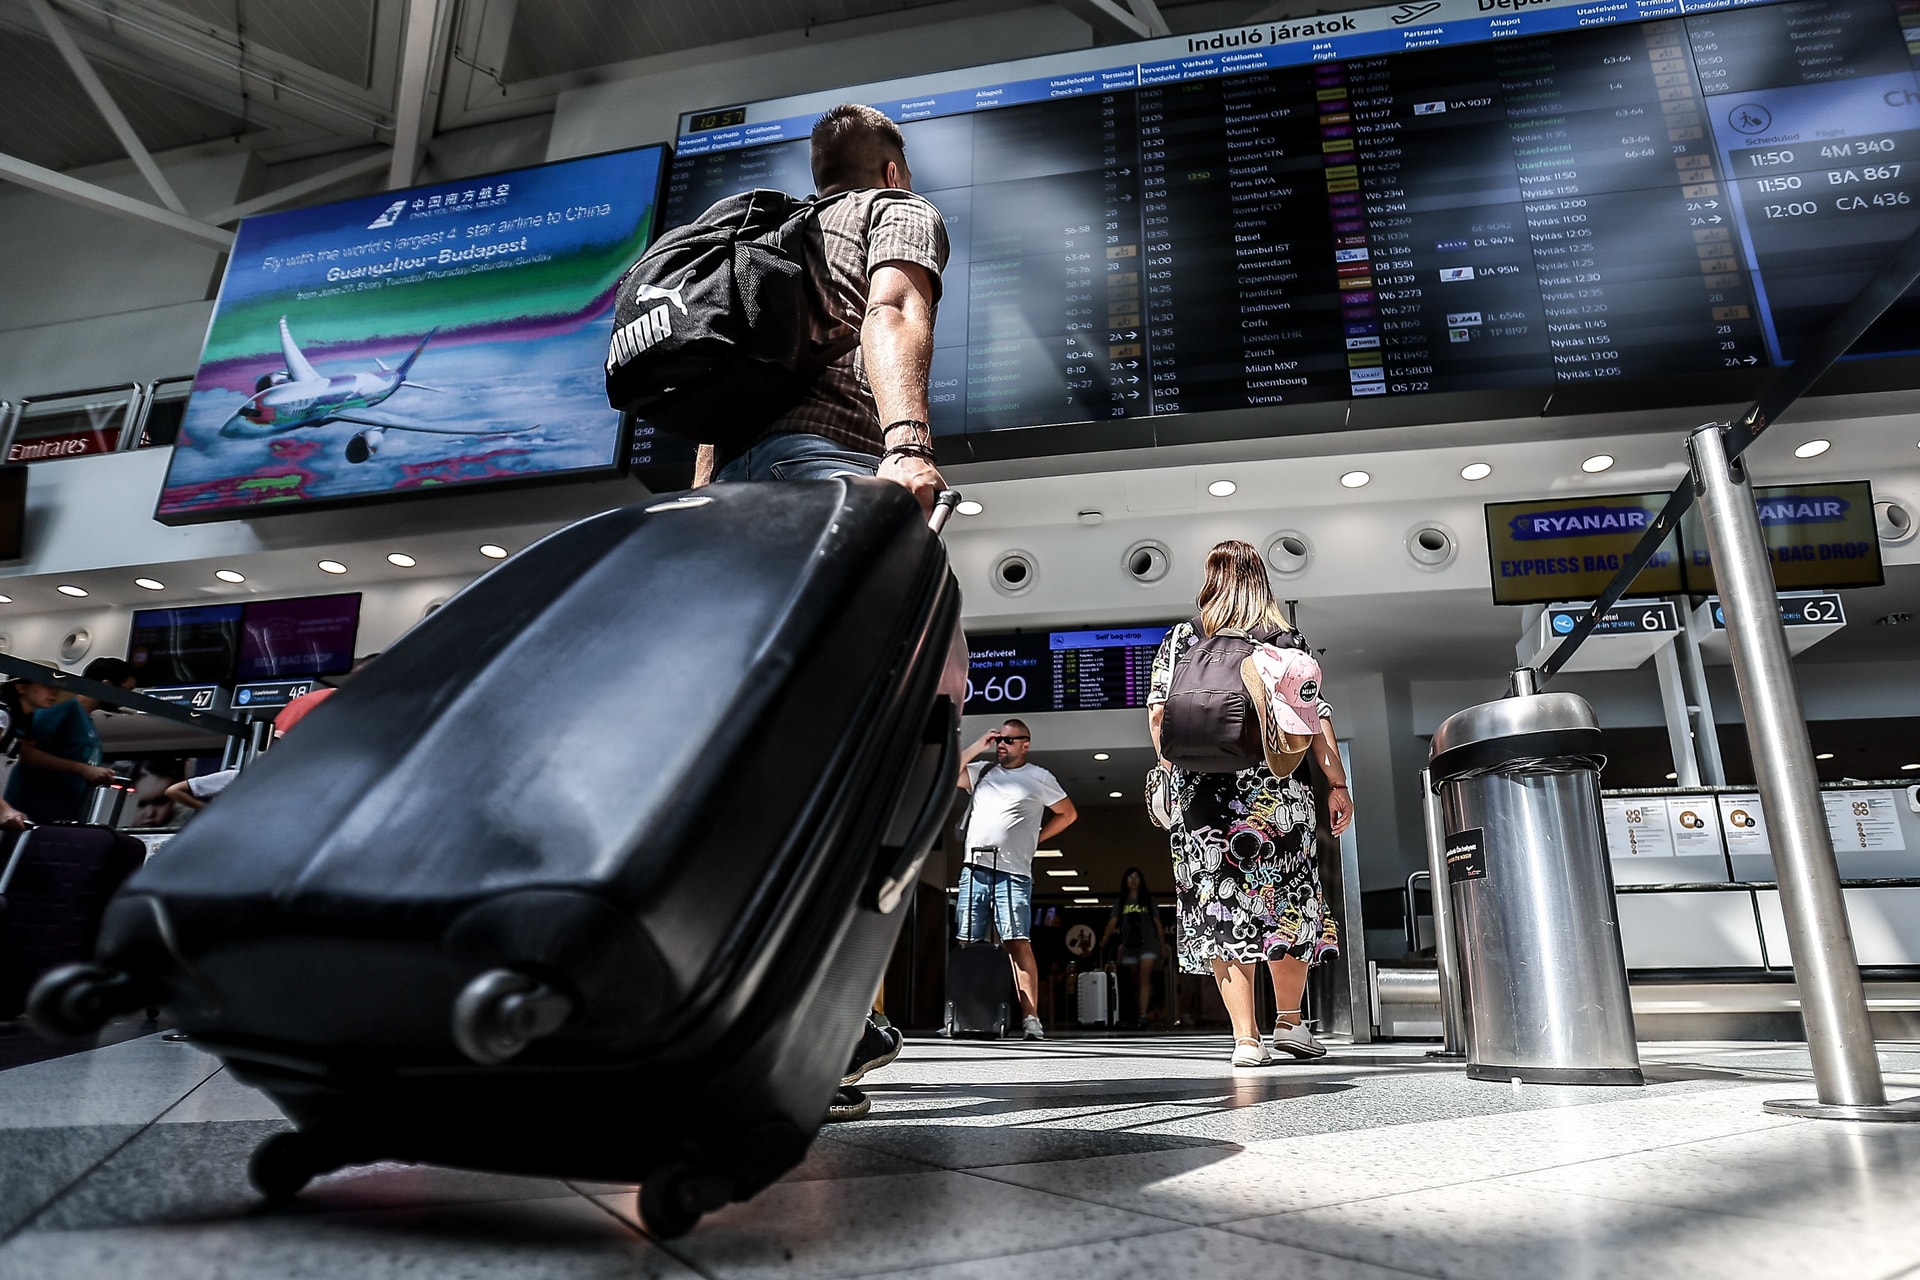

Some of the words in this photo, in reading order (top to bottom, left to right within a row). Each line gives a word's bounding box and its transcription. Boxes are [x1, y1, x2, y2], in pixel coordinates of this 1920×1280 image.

[1577, 3, 1628, 16] Utasfelvétel
[1639, 6, 1677, 18] Terminal
[1580, 15, 1616, 26] Check-in
[1188, 29, 1262, 52] Induló
[1270, 16, 1357, 44] járatok
[1404, 27, 1444, 38] Partnerek
[1492, 29, 1518, 38] Status
[1312, 42, 1332, 50] Járat
[1406, 38, 1440, 49] Partners
[1313, 52, 1337, 61] Flight
[1604, 55, 1631, 64] 63-64
[1142, 64, 1176, 75] Tervezett
[1222, 60, 1268, 73] Destination
[1142, 72, 1180, 84] Scheduled
[1183, 67, 1218, 79] Expected
[1050, 87, 1083, 97] Check-in
[976, 99, 998, 107] Status
[1450, 102, 1465, 110] UA
[1468, 98, 1492, 107] 9037
[1225, 113, 1268, 124] Bucharest
[1271, 109, 1290, 118] OTP
[1226, 126, 1259, 136] Munich
[1228, 141, 1253, 149] Rome
[1255, 137, 1275, 146] FCO
[1746, 134, 1800, 146] Scheduled
[1228, 153, 1262, 162] London
[1263, 150, 1284, 158] STN
[1750, 151, 1794, 167] 11:50
[1820, 146, 1851, 159] 4M
[1856, 139, 1896, 155] 340
[1229, 165, 1268, 175] Stuttgart
[1231, 180, 1253, 189] Paris
[1255, 177, 1276, 186] BVA
[1758, 177, 1802, 193] 11:50
[1828, 171, 1859, 185] BA
[1864, 165, 1901, 181] 867
[412, 184, 510, 211] 中国南方航空
[1232, 192, 1268, 201] Istanbul
[1270, 188, 1293, 197] SAW
[1233, 207, 1259, 215] Rome
[1261, 203, 1282, 211] FCO
[1686, 203, 1702, 211] 2A
[1764, 202, 1818, 219] 12:00
[1836, 197, 1869, 211] CA
[1873, 192, 1911, 207] 436
[1234, 220, 1267, 228] Athens
[1690, 218, 1705, 226] 2A
[263, 256, 281, 272] Fly
[286, 251, 315, 266] with
[318, 248, 339, 262] the
[343, 240, 392, 257] world's
[395, 231, 444, 250] largest
[466, 222, 496, 238] star
[498, 214, 543, 233] airline
[547, 211, 561, 223] to
[566, 204, 610, 221] China
[1235, 233, 1260, 243] Basel
[1475, 238, 1488, 247] DL
[1490, 237, 1514, 245] 9474
[1148, 243, 1172, 252] 14:00
[1236, 246, 1273, 256] Istanbul
[1276, 244, 1290, 252] IST
[1148, 257, 1172, 266] 14:00
[1238, 259, 1291, 270] Amsterdam
[1149, 271, 1172, 280] 14:05
[1479, 267, 1495, 276] UA
[1498, 265, 1519, 274] 9514
[1238, 272, 1298, 285] Copenhagen
[1378, 278, 1391, 286] LH
[1394, 275, 1415, 284] 1339
[1240, 289, 1283, 299] Frankfurt
[1379, 292, 1396, 301] W6
[1398, 289, 1422, 298] 2273
[1241, 302, 1290, 314] Eindhoven
[1242, 319, 1268, 328] Corfu
[1067, 338, 1076, 346] 16
[1110, 333, 1123, 341] 2A
[1243, 334, 1279, 343] London
[1588, 336, 1610, 345] 11:55
[1066, 351, 1094, 360] 40-46
[1244, 348, 1275, 358] Zurich
[1591, 351, 1619, 361] 13:00
[1246, 364, 1272, 373] Milan
[1275, 361, 1298, 370] MXP
[1724, 358, 1740, 367] 2A
[1067, 366, 1086, 374] 8-10
[1594, 368, 1621, 377] 12:05
[1154, 372, 1177, 382] 14:55
[1067, 380, 1092, 390] 24-27
[1247, 377, 1308, 389] Luxembourg
[1392, 383, 1408, 393] OS
[1410, 382, 1429, 391] 722
[1154, 388, 1180, 397] 15:00
[1248, 394, 1283, 404] Vienna
[1155, 403, 1180, 412] 15:05
[8, 438, 90, 461] Emirates
[1757, 502, 1841, 520] ANAIR
[1533, 512, 1645, 534] RYANAIR
[1779, 545, 1815, 562] BAG
[1819, 542, 1869, 560] DROP
[1501, 556, 1579, 578] EXPRESS
[1584, 554, 1619, 573] BAG
[1804, 601, 1839, 621] 62
[1642, 610, 1667, 630] 61
[1110, 632, 1142, 641] bag-drop
[968, 649, 1016, 659] Utasfelvétel
[289, 686, 307, 700] 48
[192, 691, 213, 707] 47
